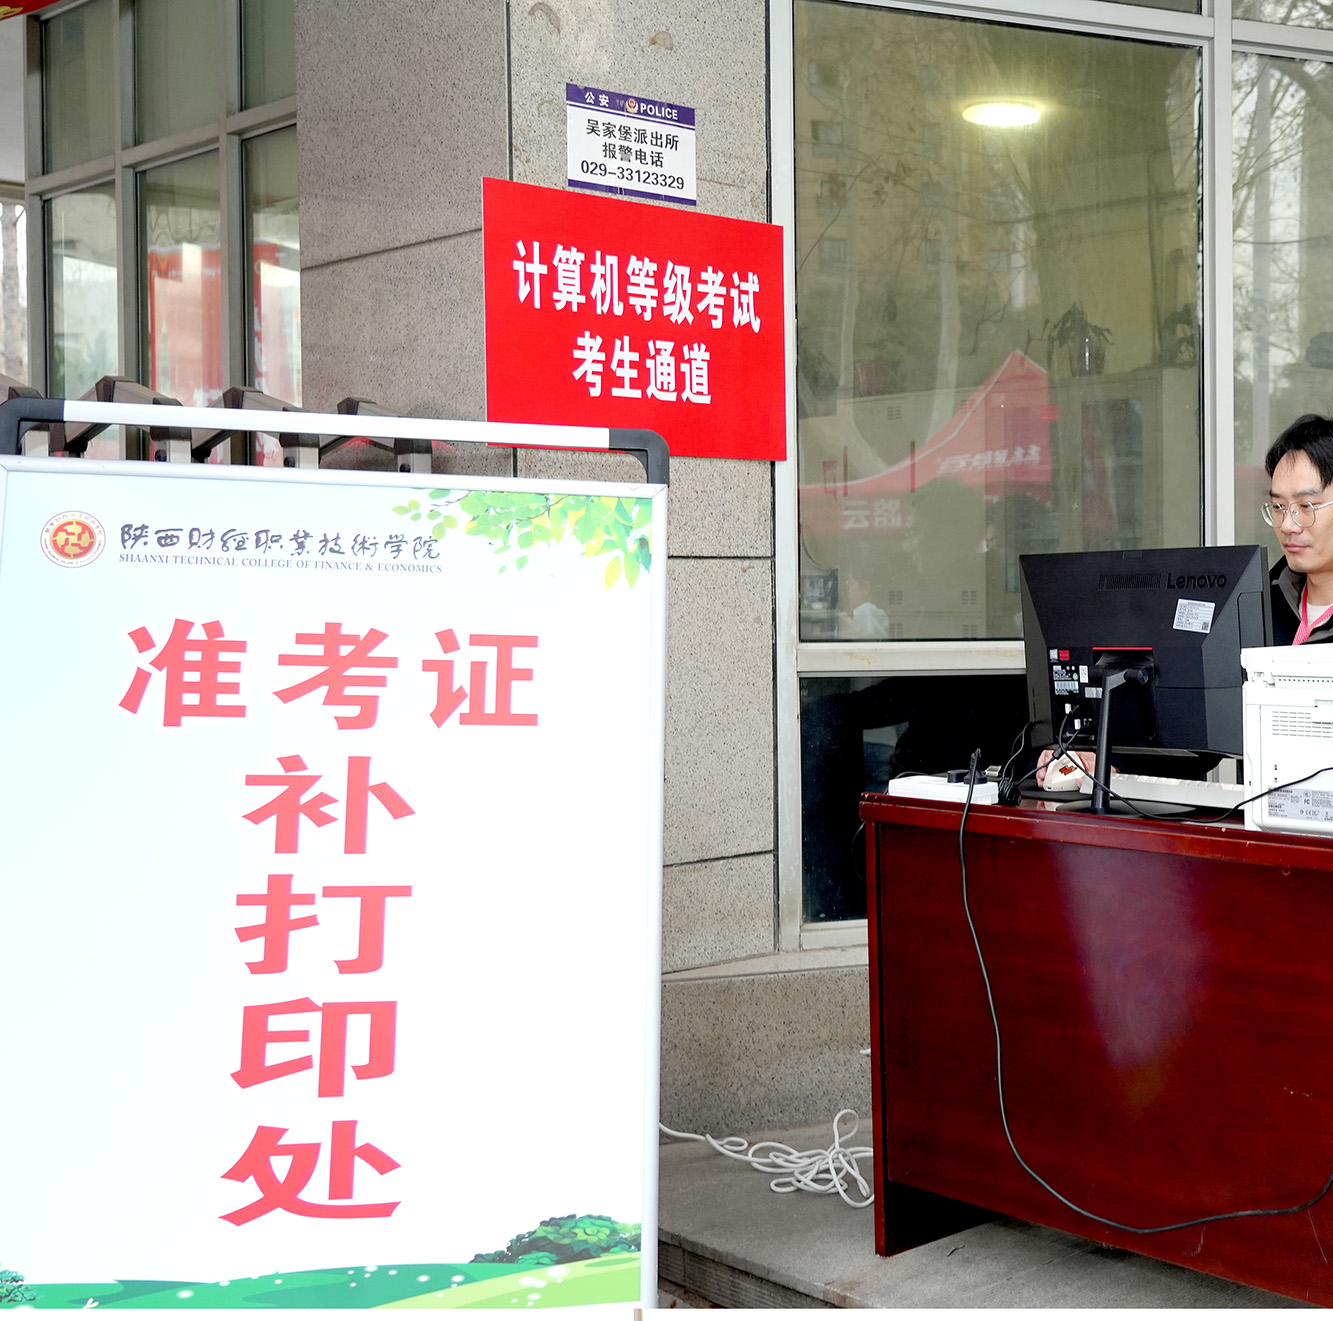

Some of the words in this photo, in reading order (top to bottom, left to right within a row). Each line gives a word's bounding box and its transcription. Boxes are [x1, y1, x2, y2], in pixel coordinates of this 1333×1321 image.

[584, 91, 610, 108] 公安
[640, 103, 679, 120] POLICE
[586, 118, 679, 151] 吴家堡派出所
[602, 142, 664, 168] 报警电话
[580, 160, 685, 190] 029-33123329
[512, 240, 762, 334] 计算机等级考试
[571, 330, 713, 406] 考生通道
[118, 553, 169, 565] SHAANXI
[173, 555, 238, 567] TECHNICAL
[241, 557, 293, 568] COLLEGE
[296, 559, 311, 569] OF
[314, 560, 362, 571] FINANCE
[365, 562, 374, 572] &
[377, 562, 443, 574] ECONOMICS
[1167, 573, 1227, 589] Lenovo
[118, 617, 540, 730] 准考证
[218, 754, 417, 1229] 补打印处
